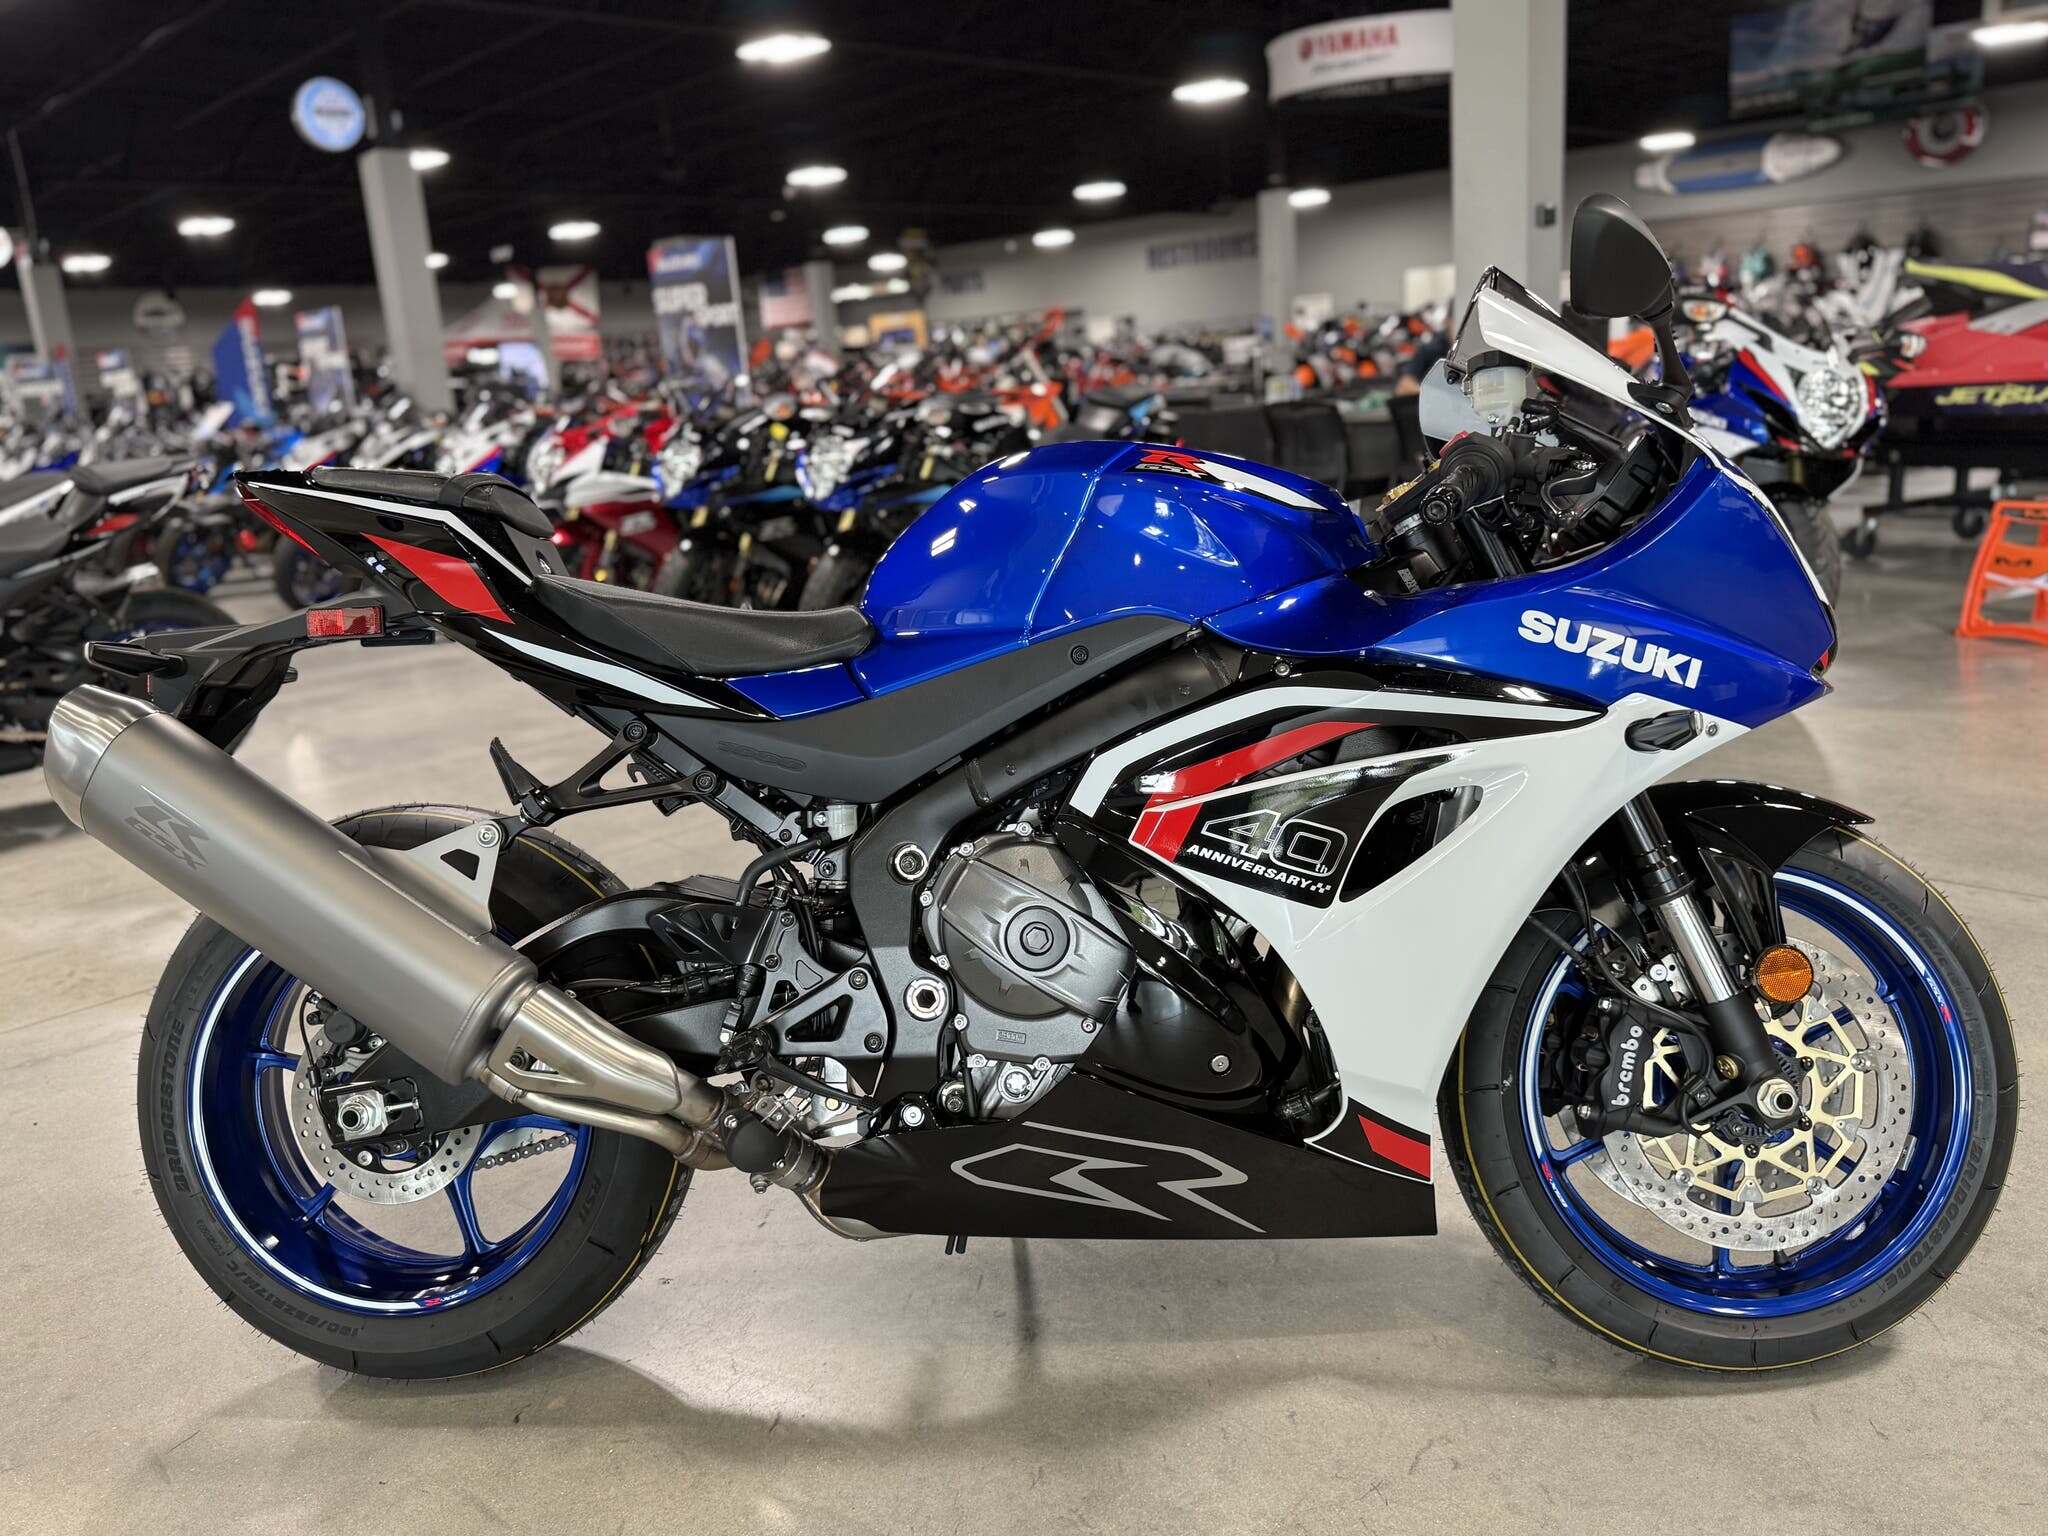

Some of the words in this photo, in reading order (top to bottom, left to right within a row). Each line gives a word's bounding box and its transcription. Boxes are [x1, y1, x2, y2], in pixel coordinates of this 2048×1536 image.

[1518, 609, 1703, 690] SUZUKI
[1187, 845, 1312, 889] ANNIVERSARY
[1201, 809, 1348, 877] 40
[1611, 1025, 1643, 1107] brembo
